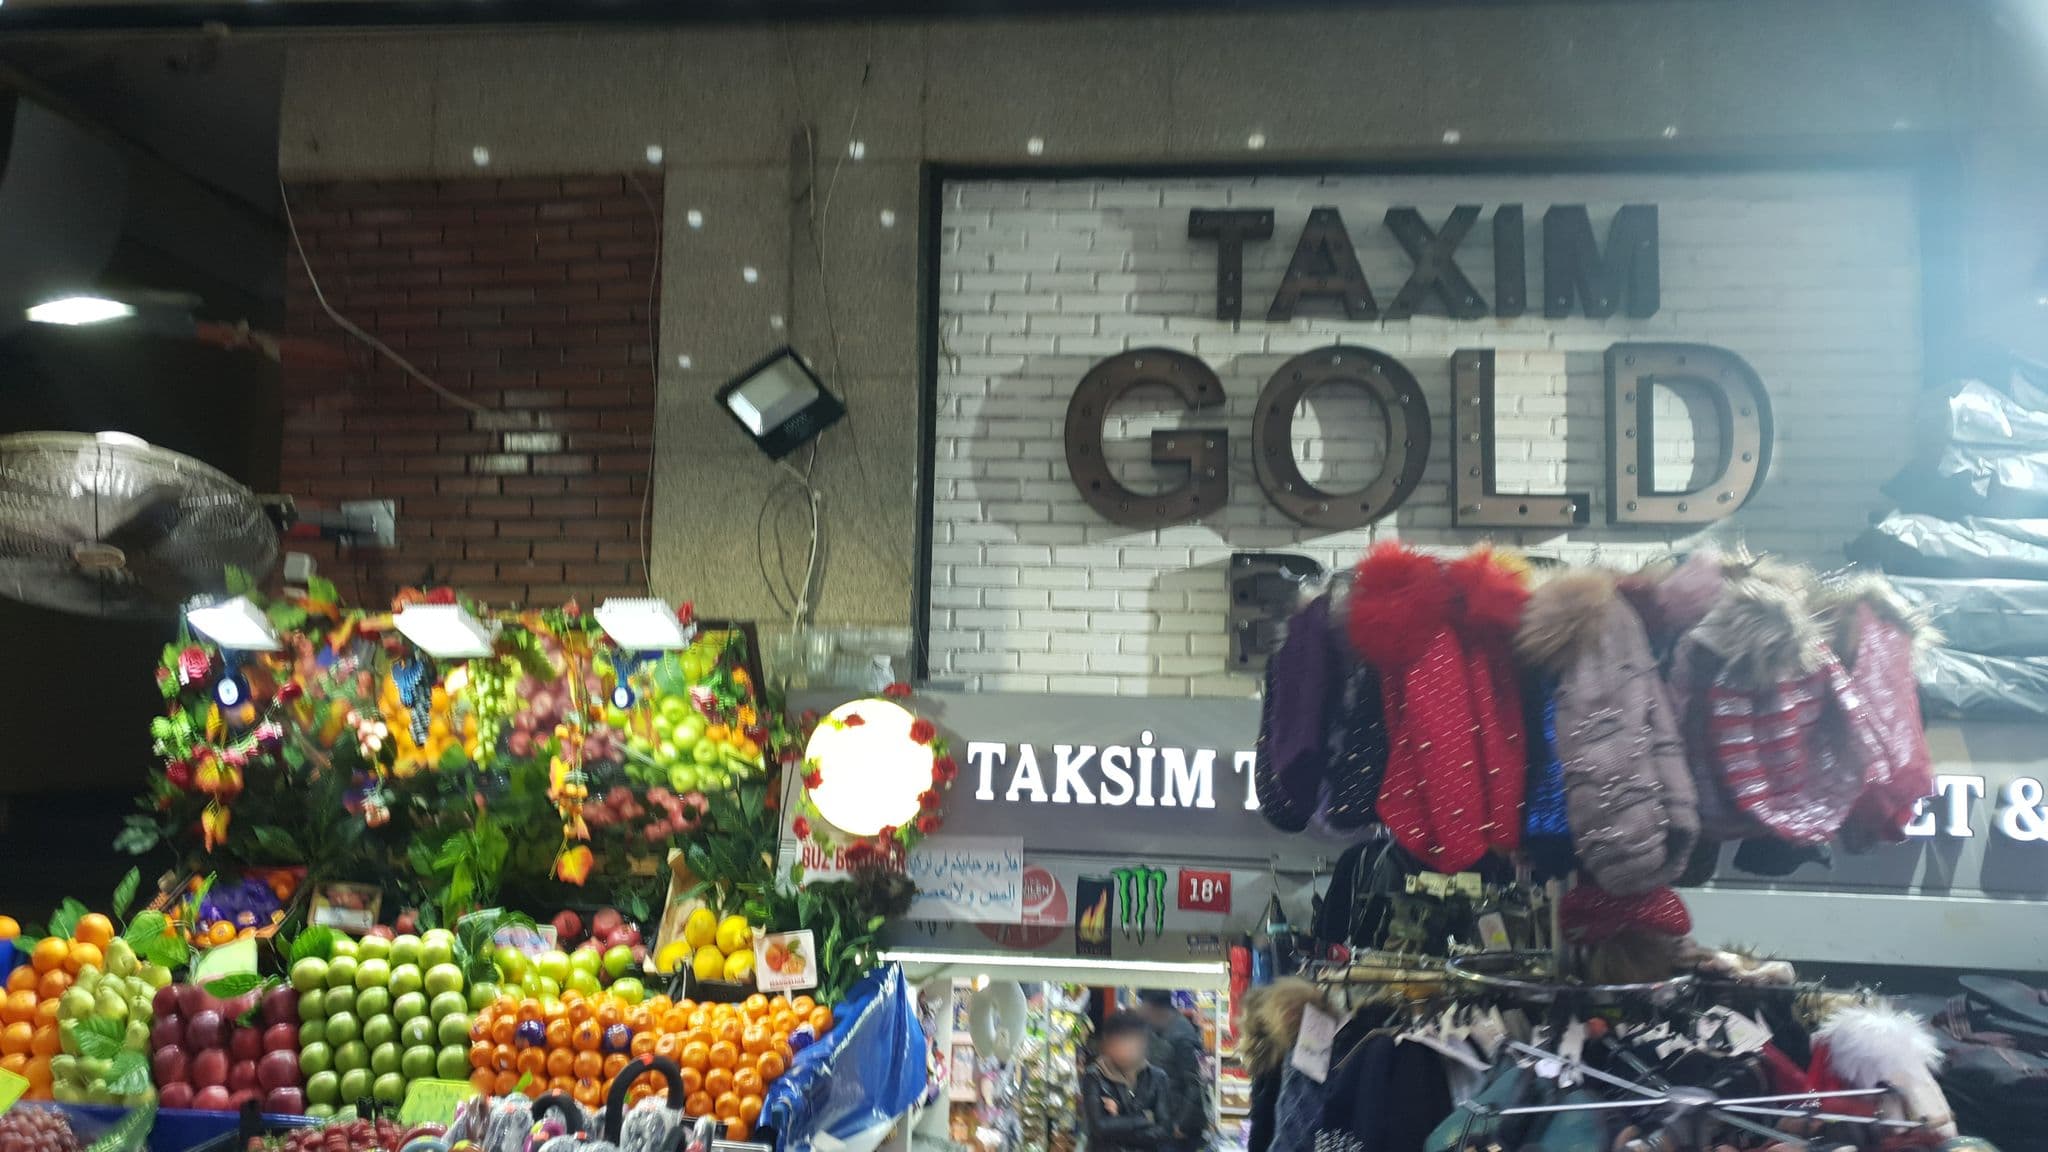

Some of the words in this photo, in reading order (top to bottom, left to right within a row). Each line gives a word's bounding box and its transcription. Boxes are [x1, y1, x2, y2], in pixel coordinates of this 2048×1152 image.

[1188, 203, 1661, 322] TAXIM
[1064, 341, 1775, 530] GOLD
[967, 730, 1217, 809] TAKSİM
